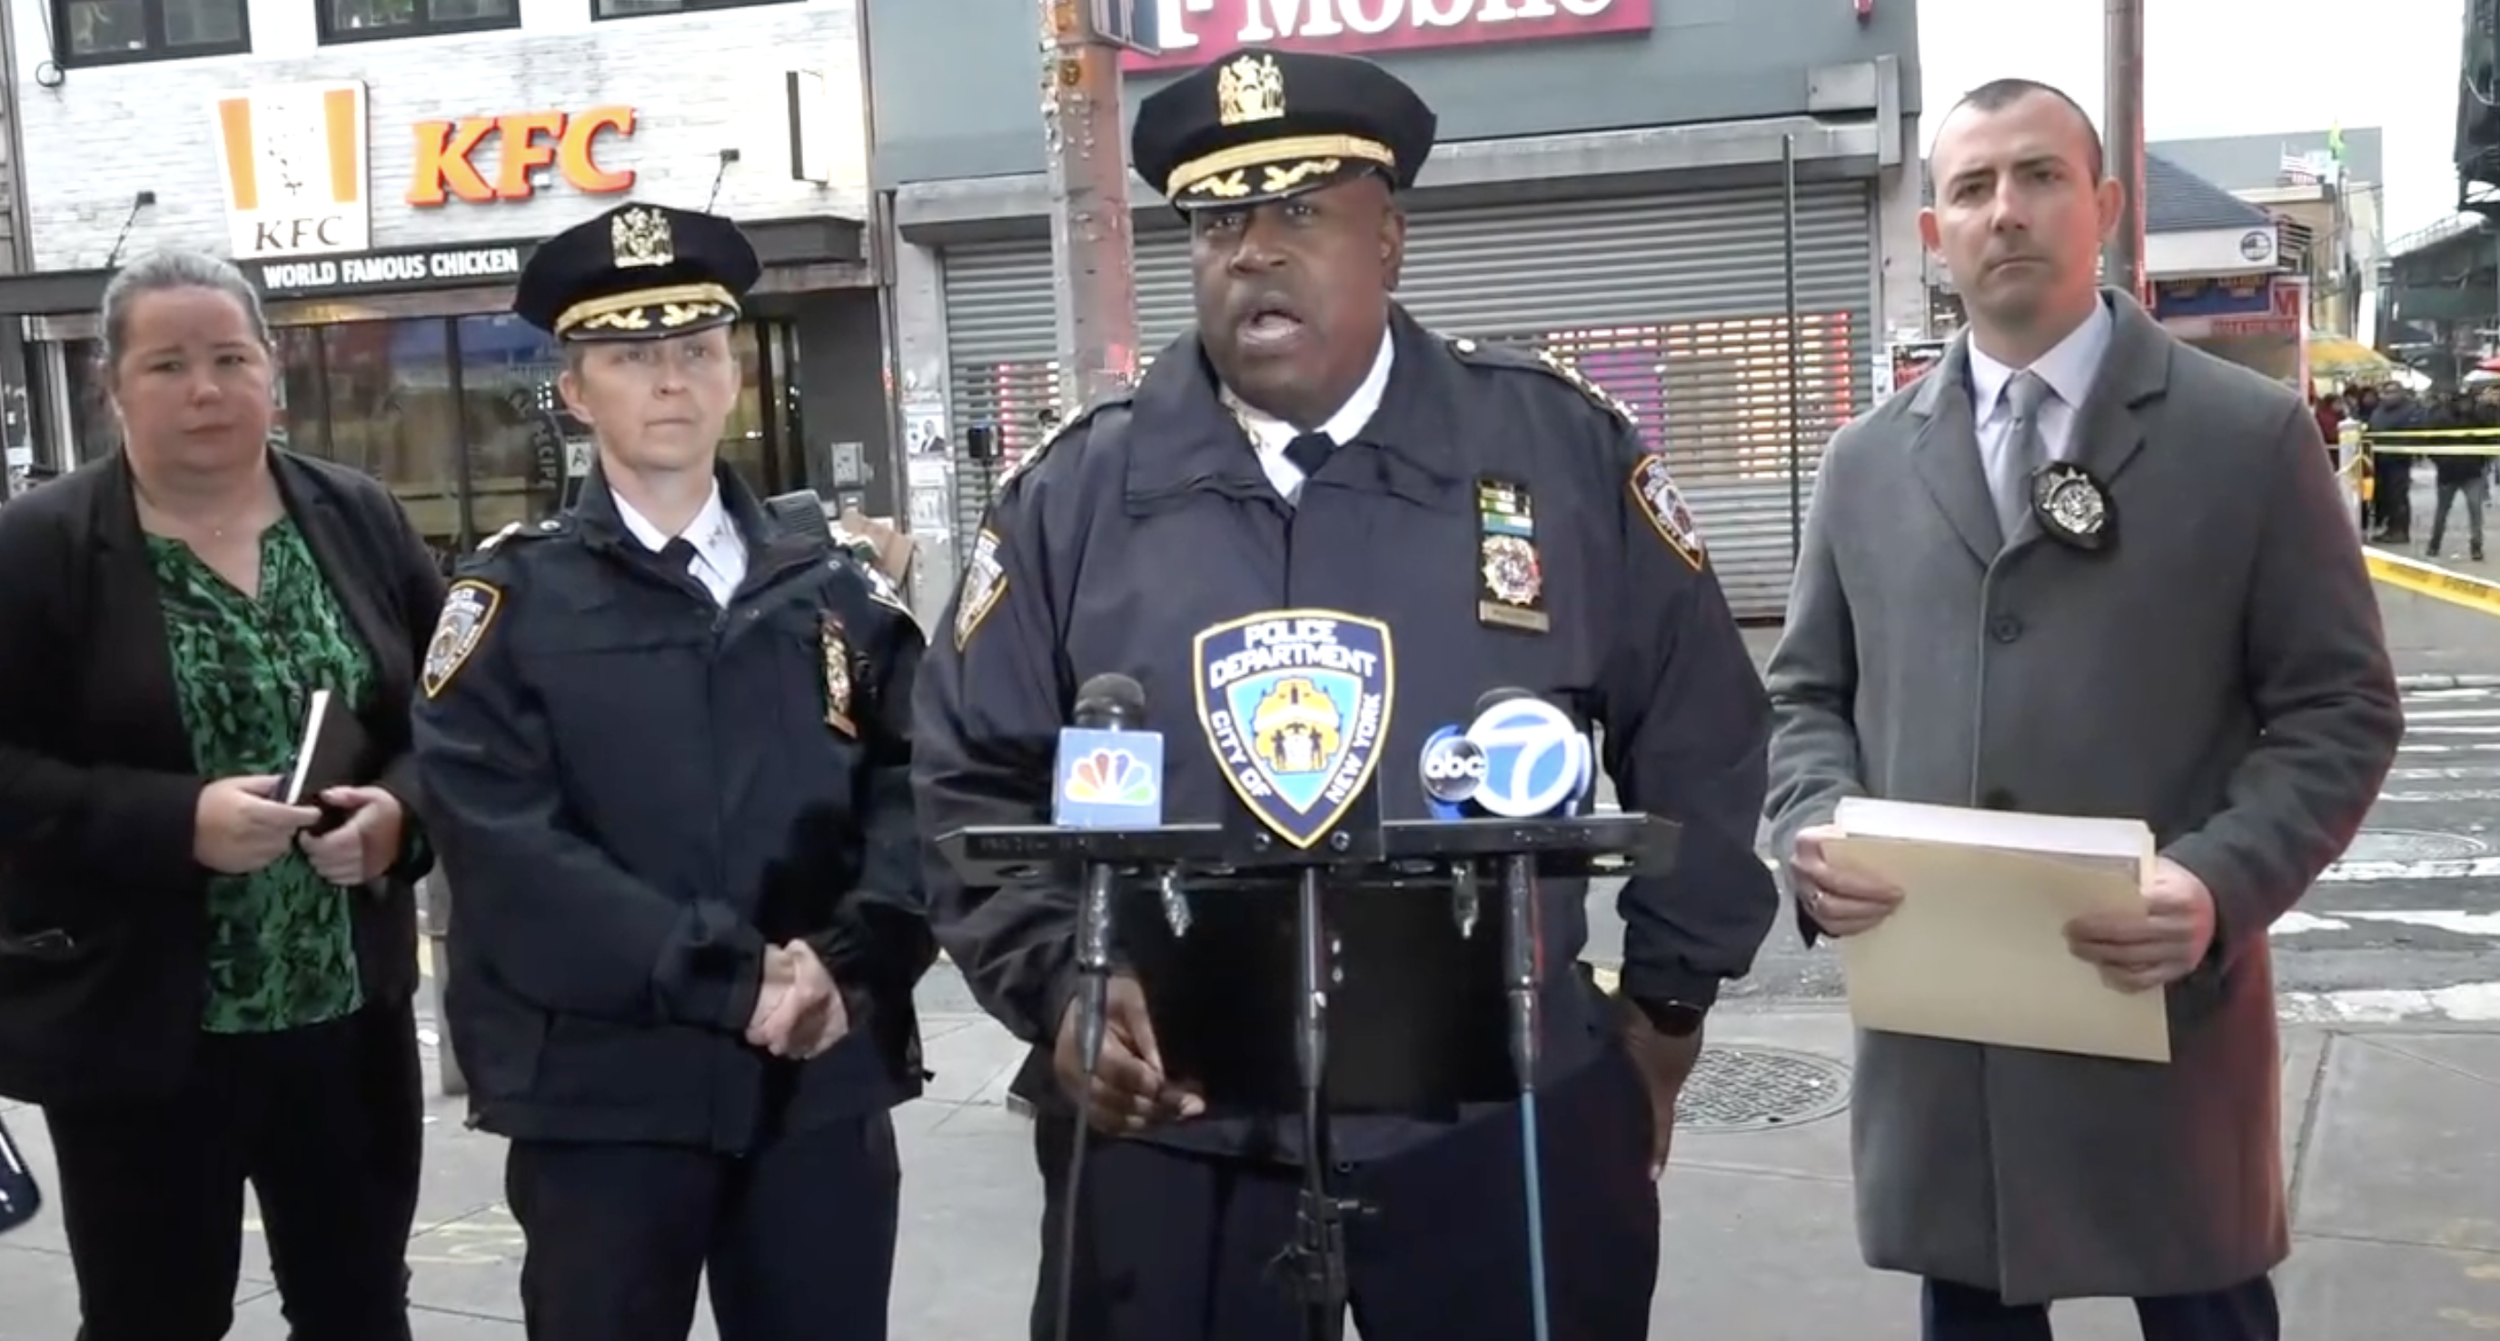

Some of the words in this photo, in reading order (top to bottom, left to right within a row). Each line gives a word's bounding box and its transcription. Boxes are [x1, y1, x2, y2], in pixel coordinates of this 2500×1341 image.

[405, 105, 637, 207] KFC
[255, 215, 343, 251] KFC
[263, 260, 337, 289] WORLD
[341, 255, 426, 283] FAMOUS
[430, 248, 519, 277] CHICKEN
[1244, 619, 1337, 649] POLICE
[1210, 643, 1377, 689] DEPARTMENT
[1210, 709, 1247, 765] CITY
[1239, 766, 1272, 797] OF
[1325, 753, 1363, 805] NEW
[1353, 693, 1381, 749] YORK
[1425, 750, 1486, 778] abc
[1482, 722, 1566, 806] 7
